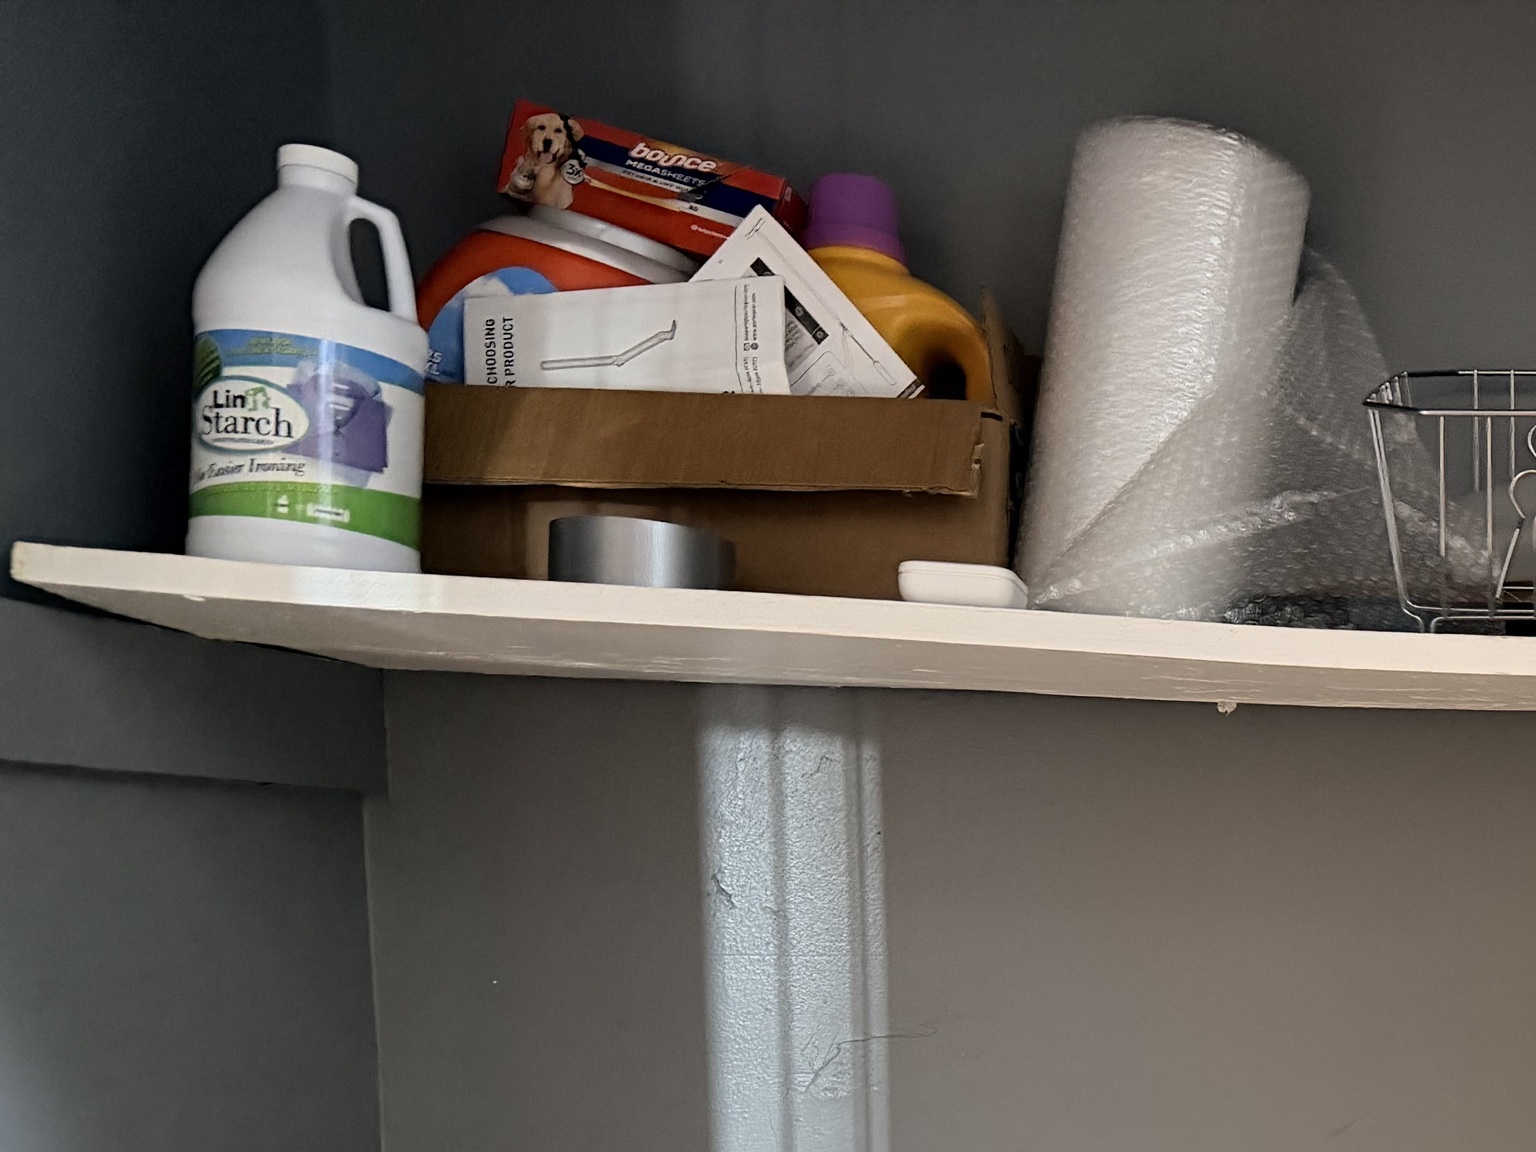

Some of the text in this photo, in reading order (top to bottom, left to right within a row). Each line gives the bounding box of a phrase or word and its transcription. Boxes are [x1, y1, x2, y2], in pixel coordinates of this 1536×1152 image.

[625, 158, 707, 187] MEGASHEETS
[628, 141, 718, 173] bounce
[484, 318, 498, 384] CHOOSING
[502, 316, 515, 377] PRODUCT
[203, 404, 294, 438] Starch
[247, 457, 307, 477] Ironing
